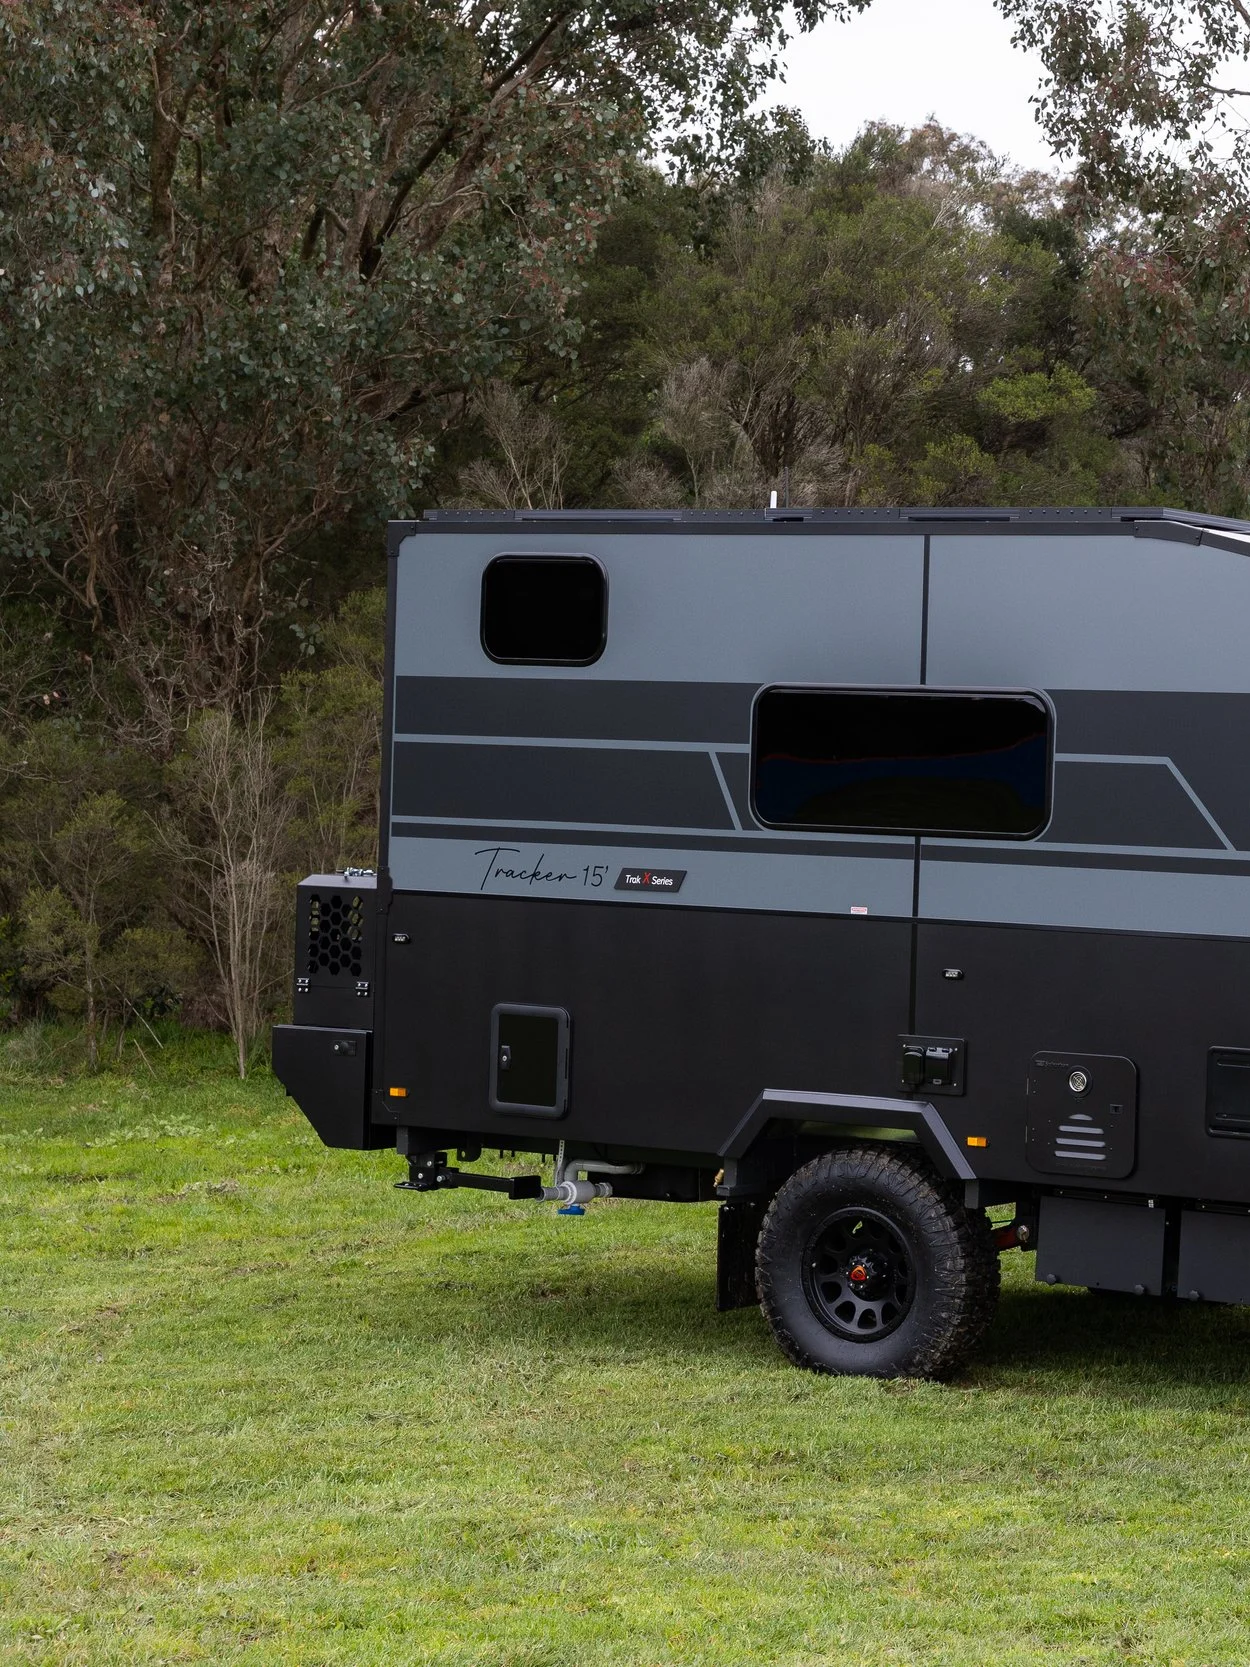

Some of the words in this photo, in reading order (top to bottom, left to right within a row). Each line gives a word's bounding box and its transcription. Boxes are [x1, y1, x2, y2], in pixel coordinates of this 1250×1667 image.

[474, 847, 577, 890] Tracker
[625, 874, 641, 884] Trak
[642, 871, 651, 885] X
[651, 875, 674, 886] Series
